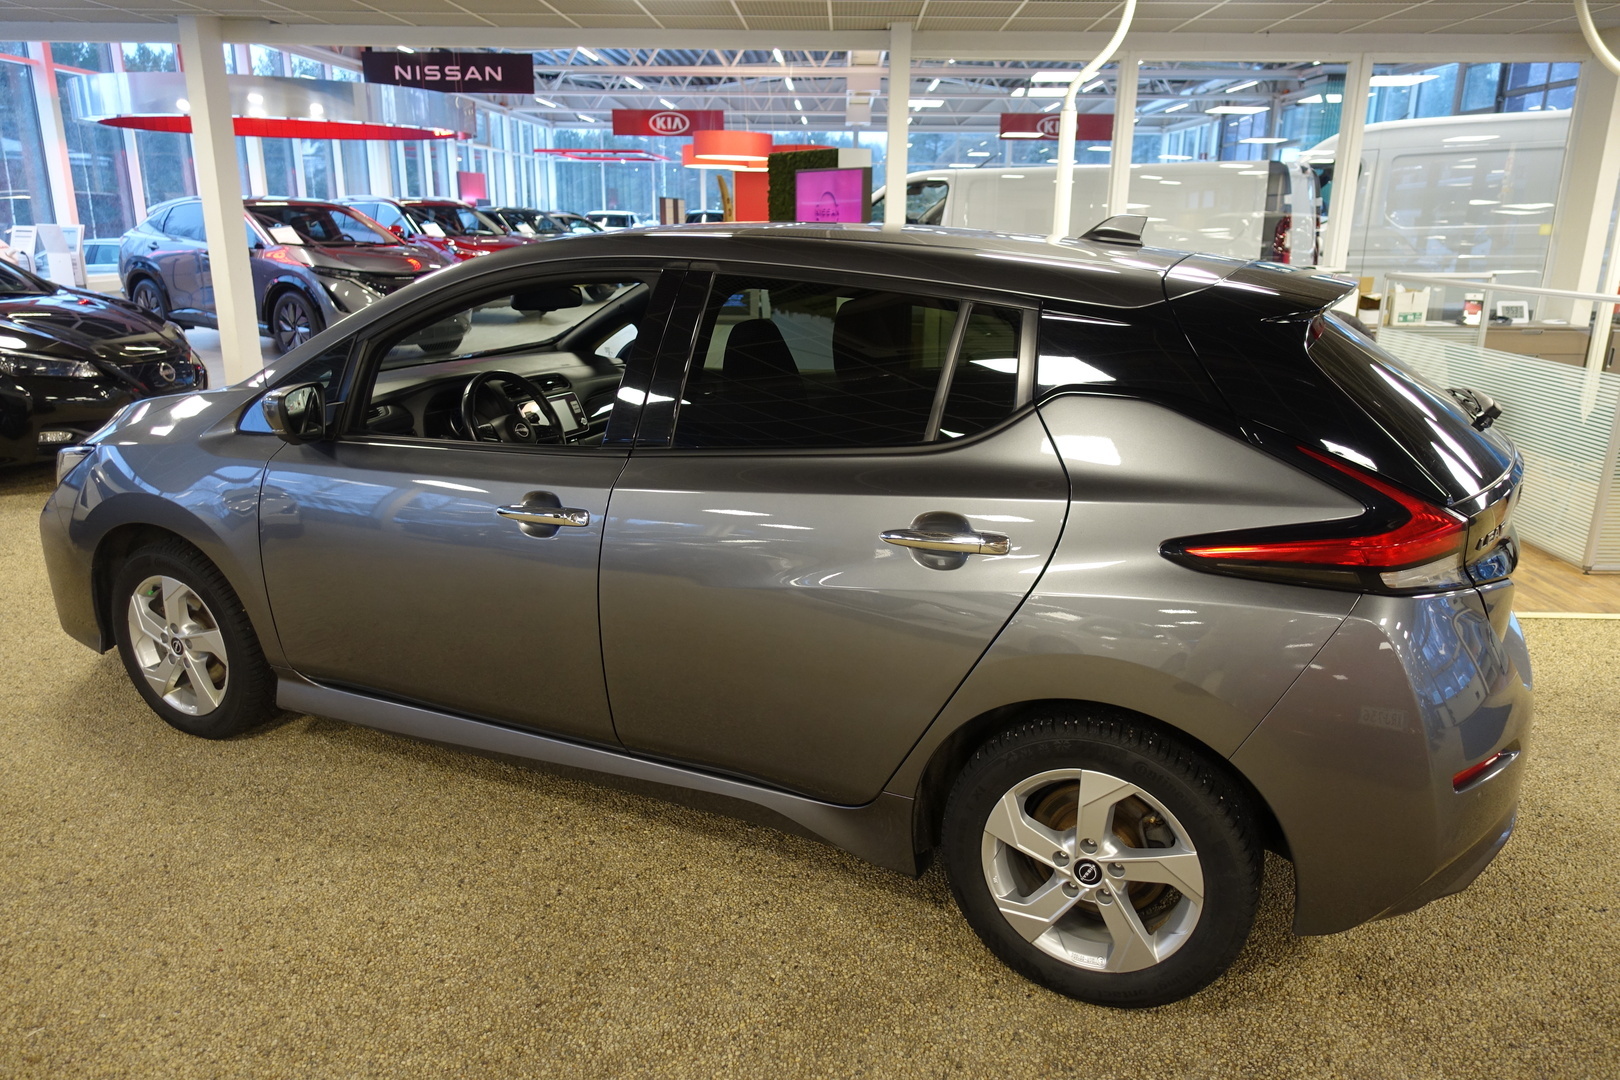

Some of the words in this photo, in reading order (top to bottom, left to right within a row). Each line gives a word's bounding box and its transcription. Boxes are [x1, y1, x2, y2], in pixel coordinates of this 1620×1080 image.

[394, 65, 503, 81] NISSAN
[655, 116, 683, 130] KIA
[1043, 120, 1060, 134] KI
[1475, 521, 1506, 551] LEAF
